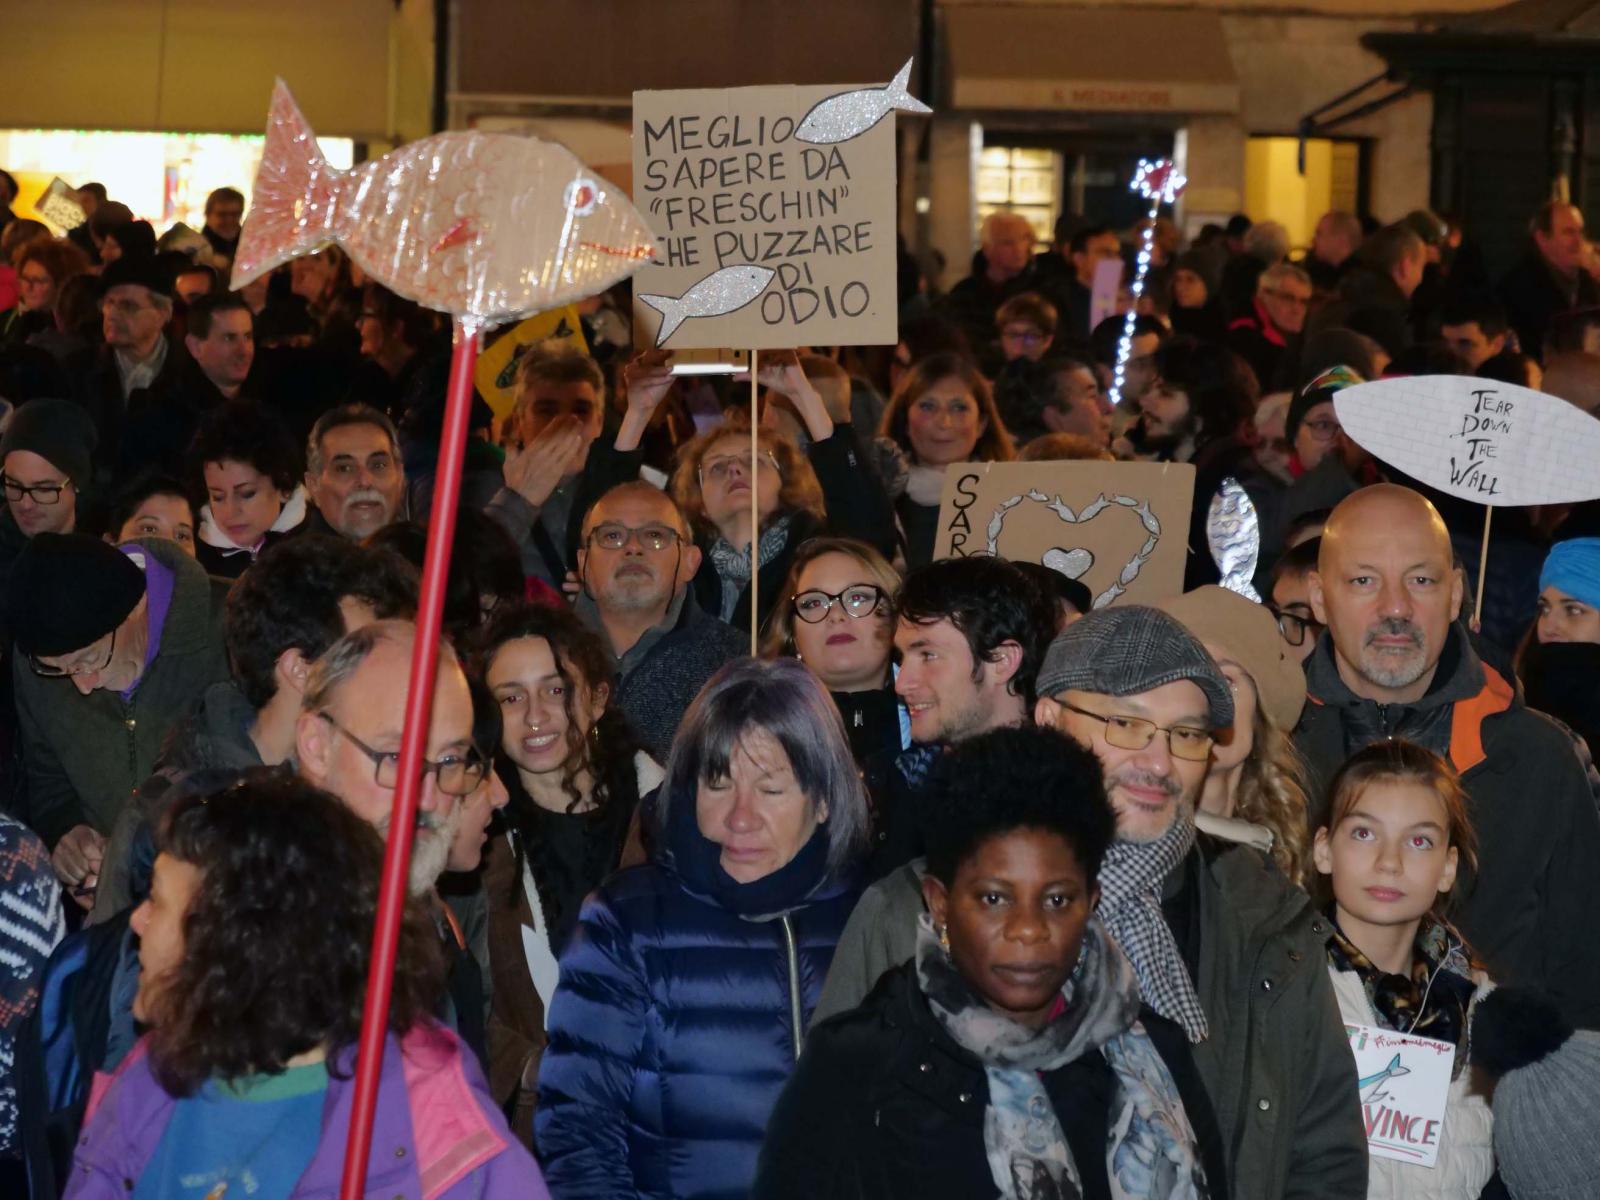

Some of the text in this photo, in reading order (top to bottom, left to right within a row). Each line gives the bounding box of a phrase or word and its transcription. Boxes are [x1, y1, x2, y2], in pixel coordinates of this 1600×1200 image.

[643, 114, 795, 156] MEGLIO
[643, 145, 851, 192] SAPERE DA
[713, 221, 873, 269] PUZZARE
[776, 261, 814, 292] DI
[1471, 390, 1514, 417] TEAR
[1449, 413, 1513, 439] DOWN
[1467, 438, 1499, 461] THE
[1449, 457, 1503, 496] WALL
